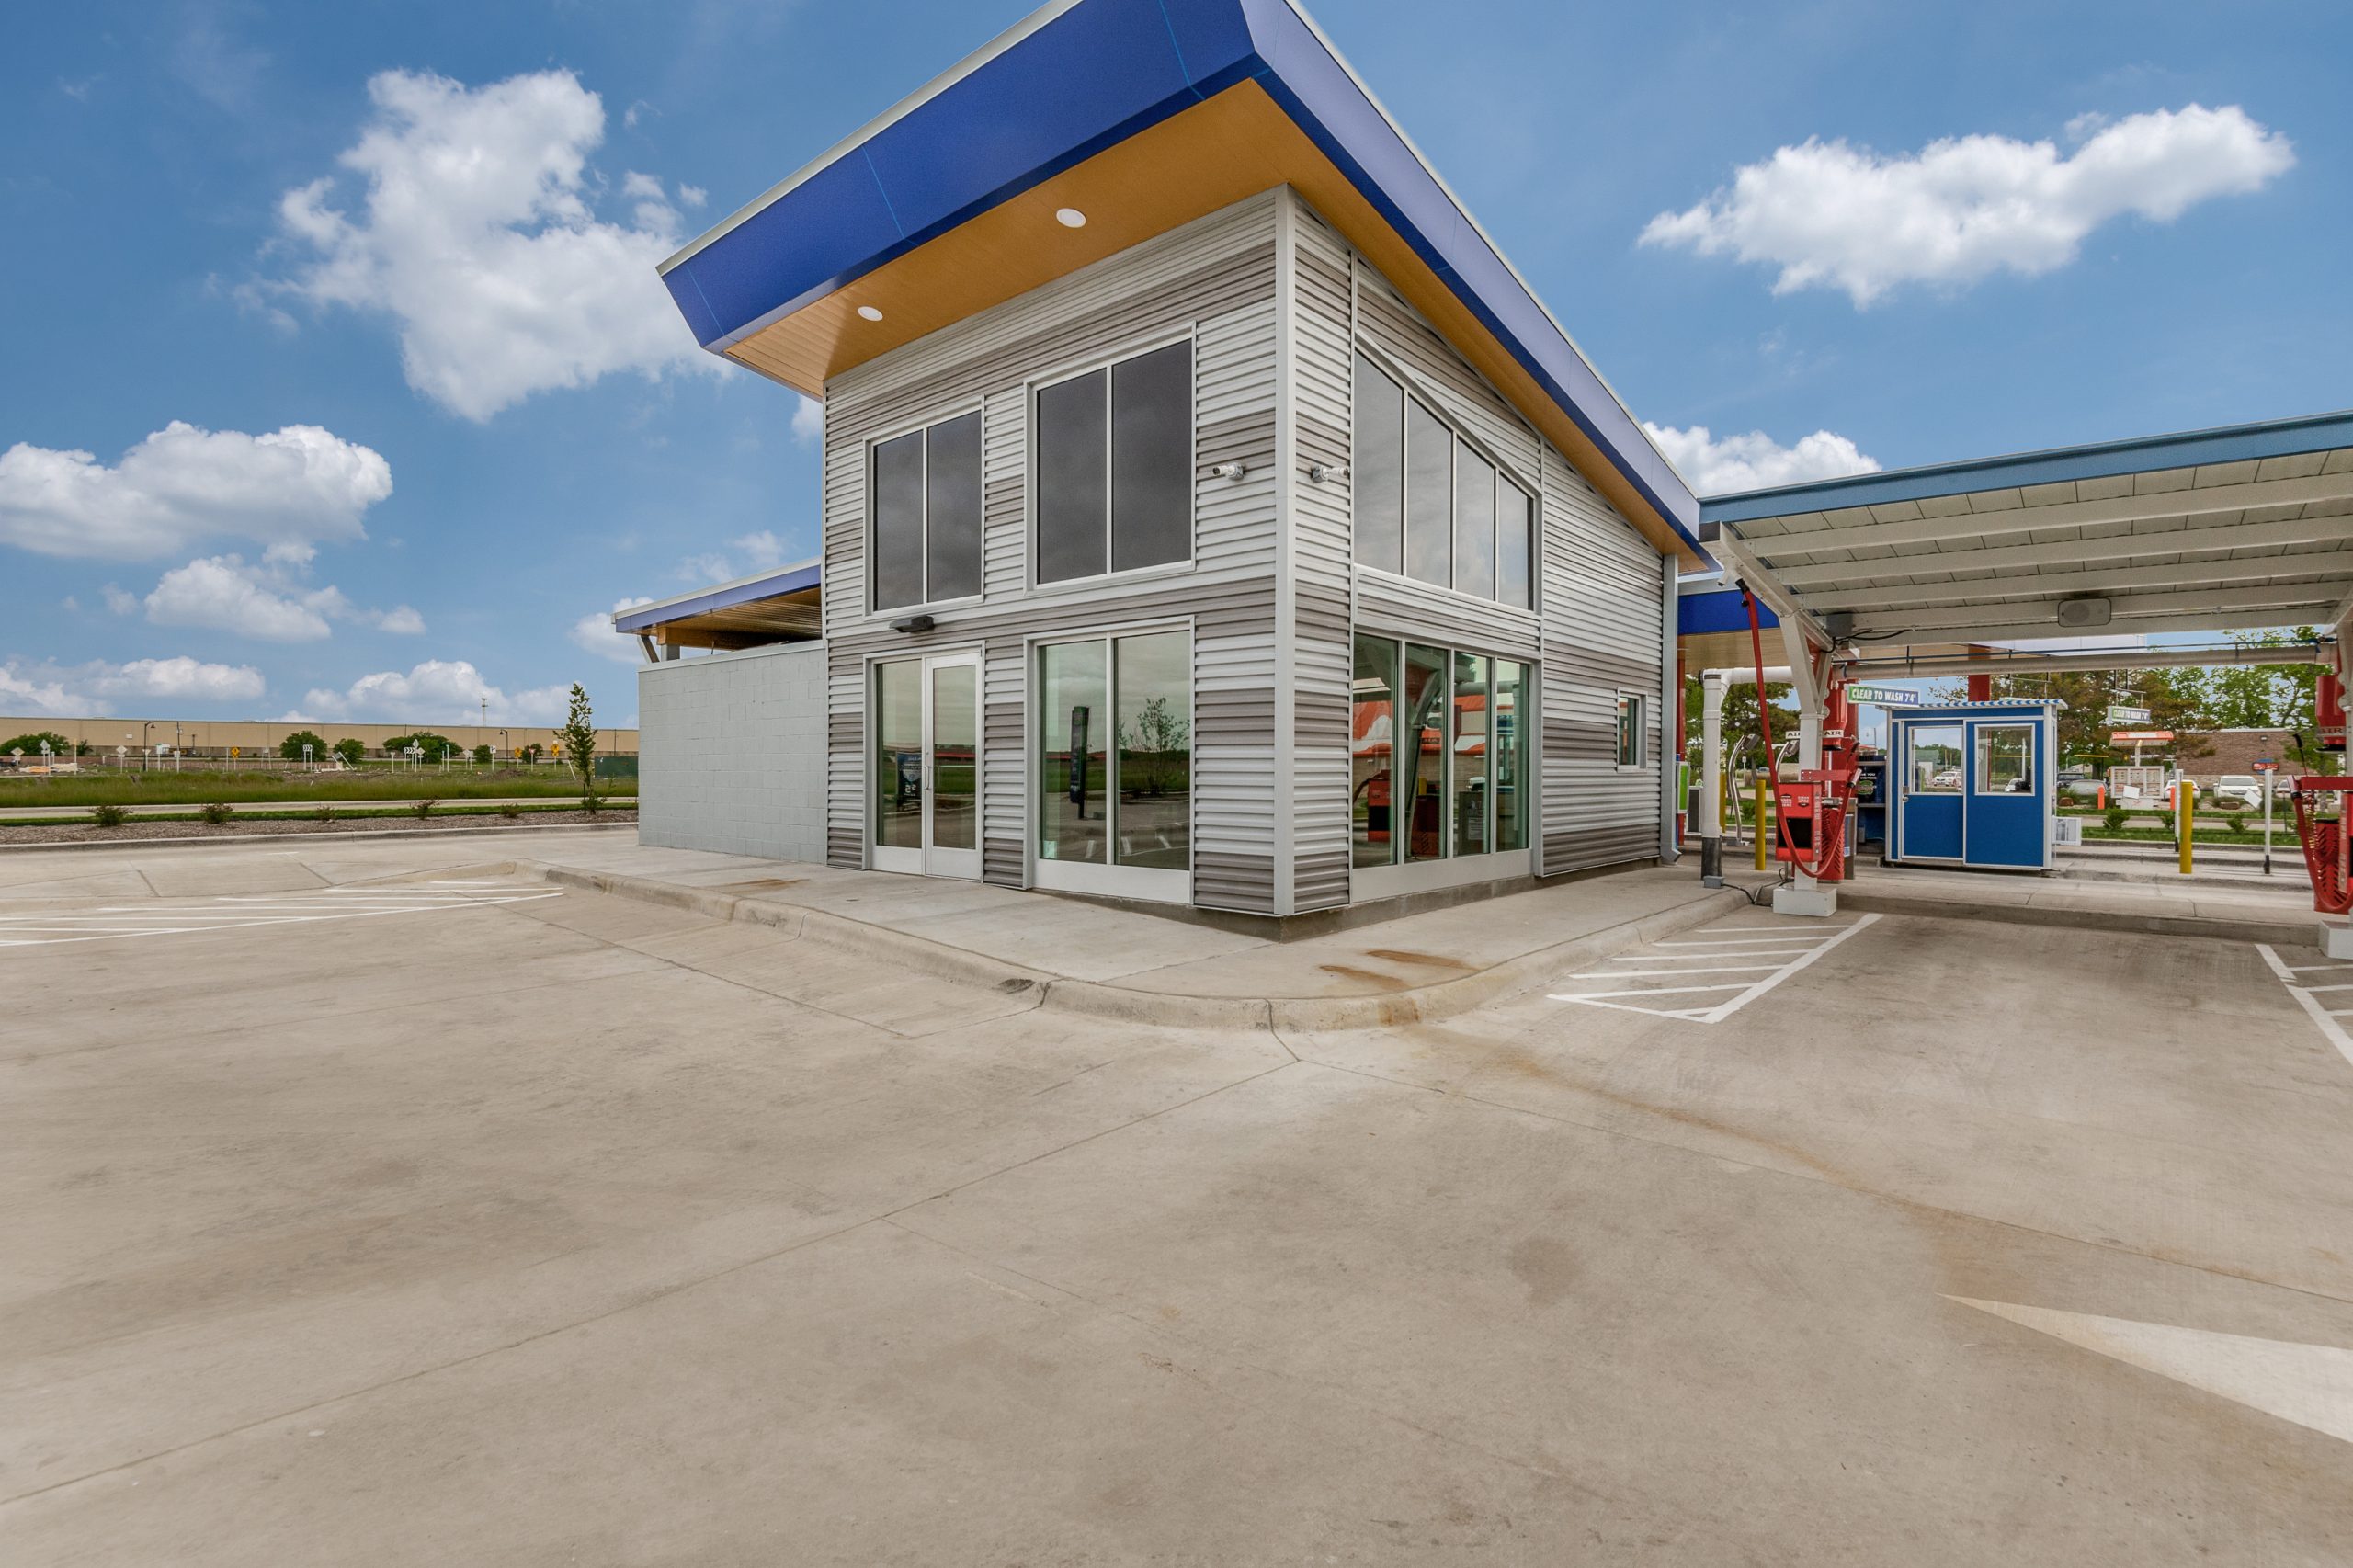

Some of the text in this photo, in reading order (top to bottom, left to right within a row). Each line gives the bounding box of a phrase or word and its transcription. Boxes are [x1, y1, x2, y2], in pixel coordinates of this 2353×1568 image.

[1851, 688, 1872, 699] CLEAR
[1874, 690, 1883, 700] TO
[1884, 691, 1904, 702] WASH
